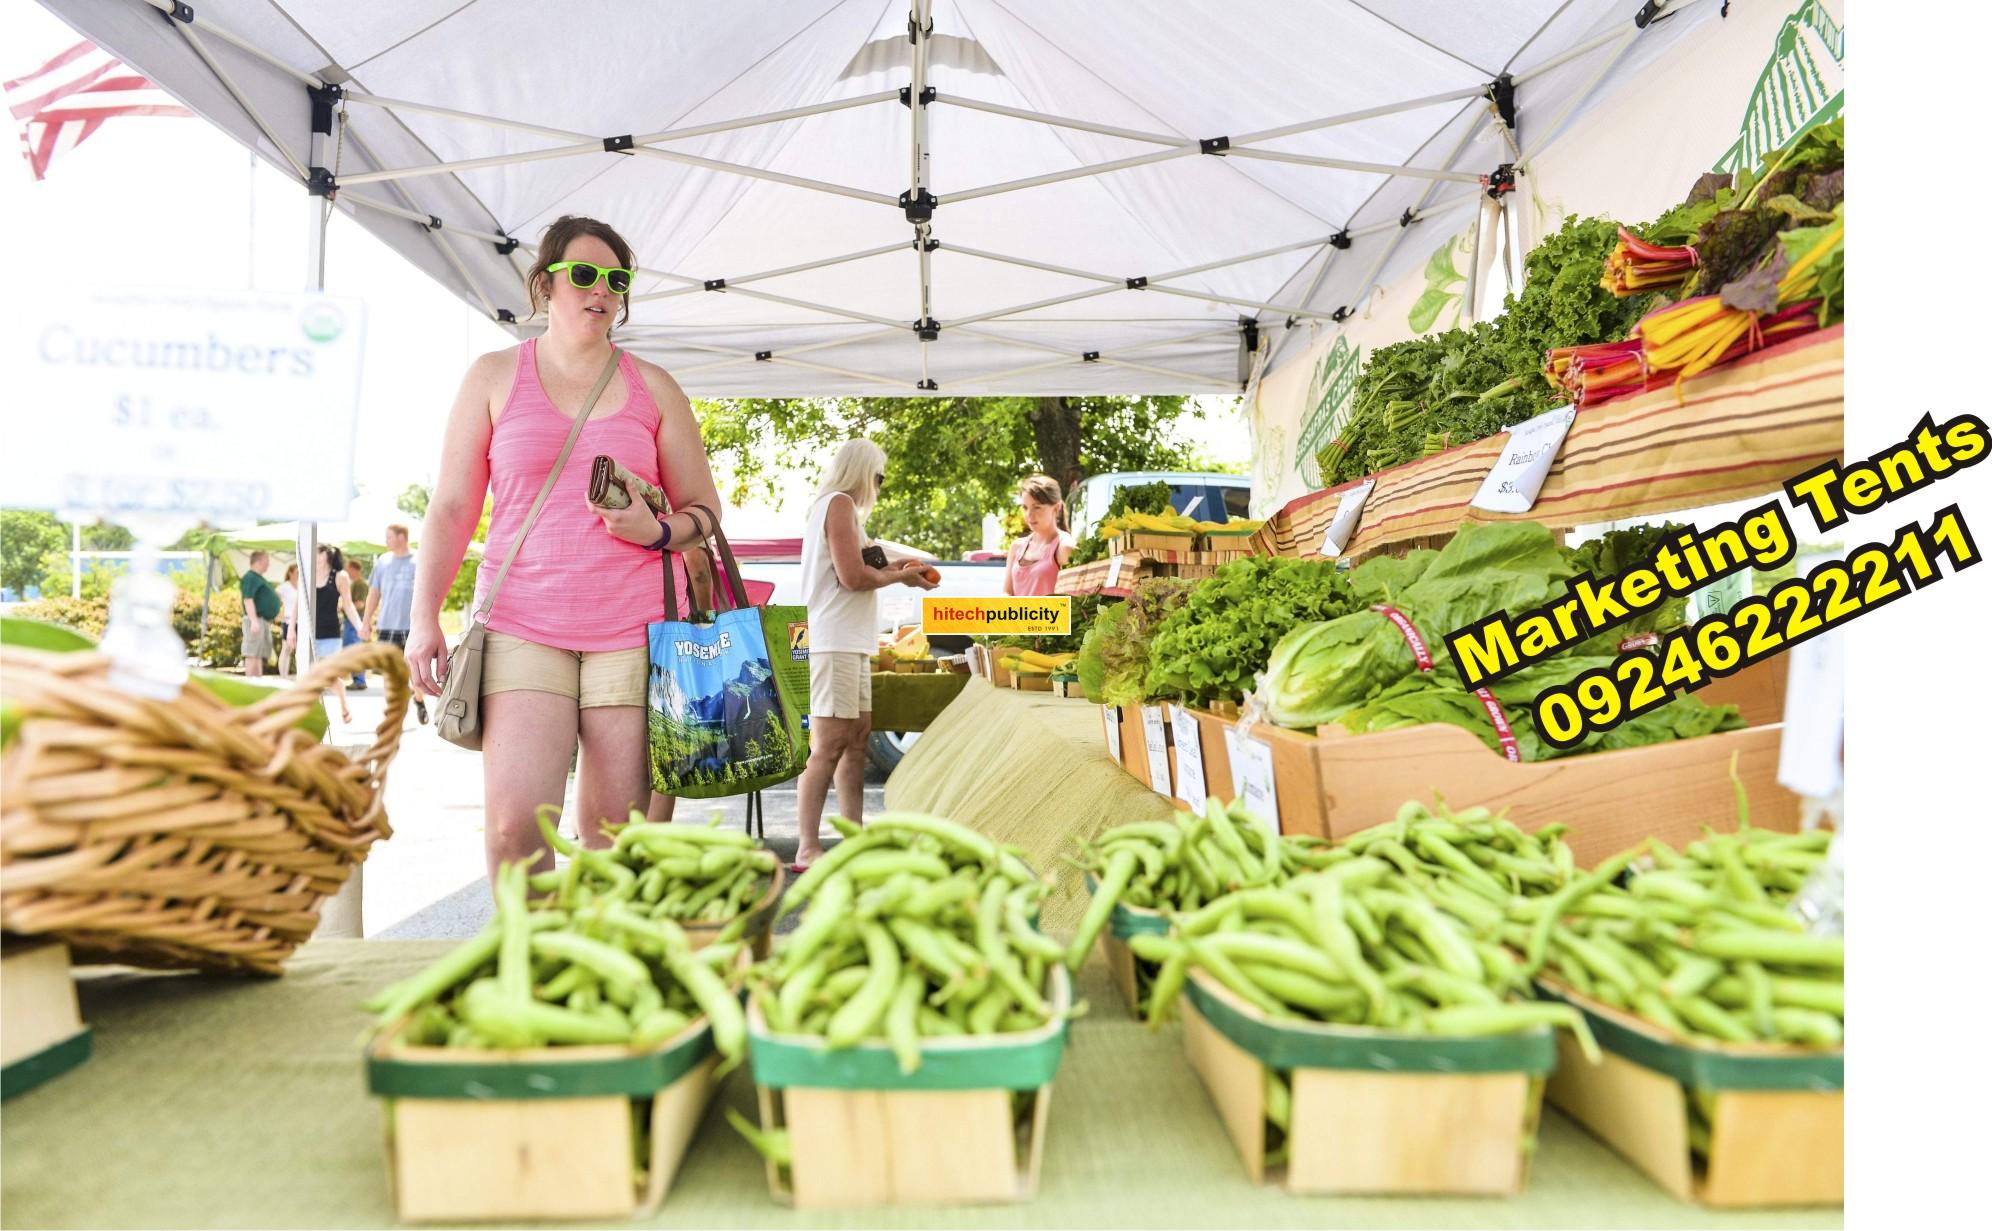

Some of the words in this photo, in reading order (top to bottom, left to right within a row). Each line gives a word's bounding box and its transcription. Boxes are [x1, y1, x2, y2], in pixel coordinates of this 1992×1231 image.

[38, 322, 316, 378] Cucumbers
[113, 393, 152, 427] $1
[674, 632, 732, 661] YOSEMIE
